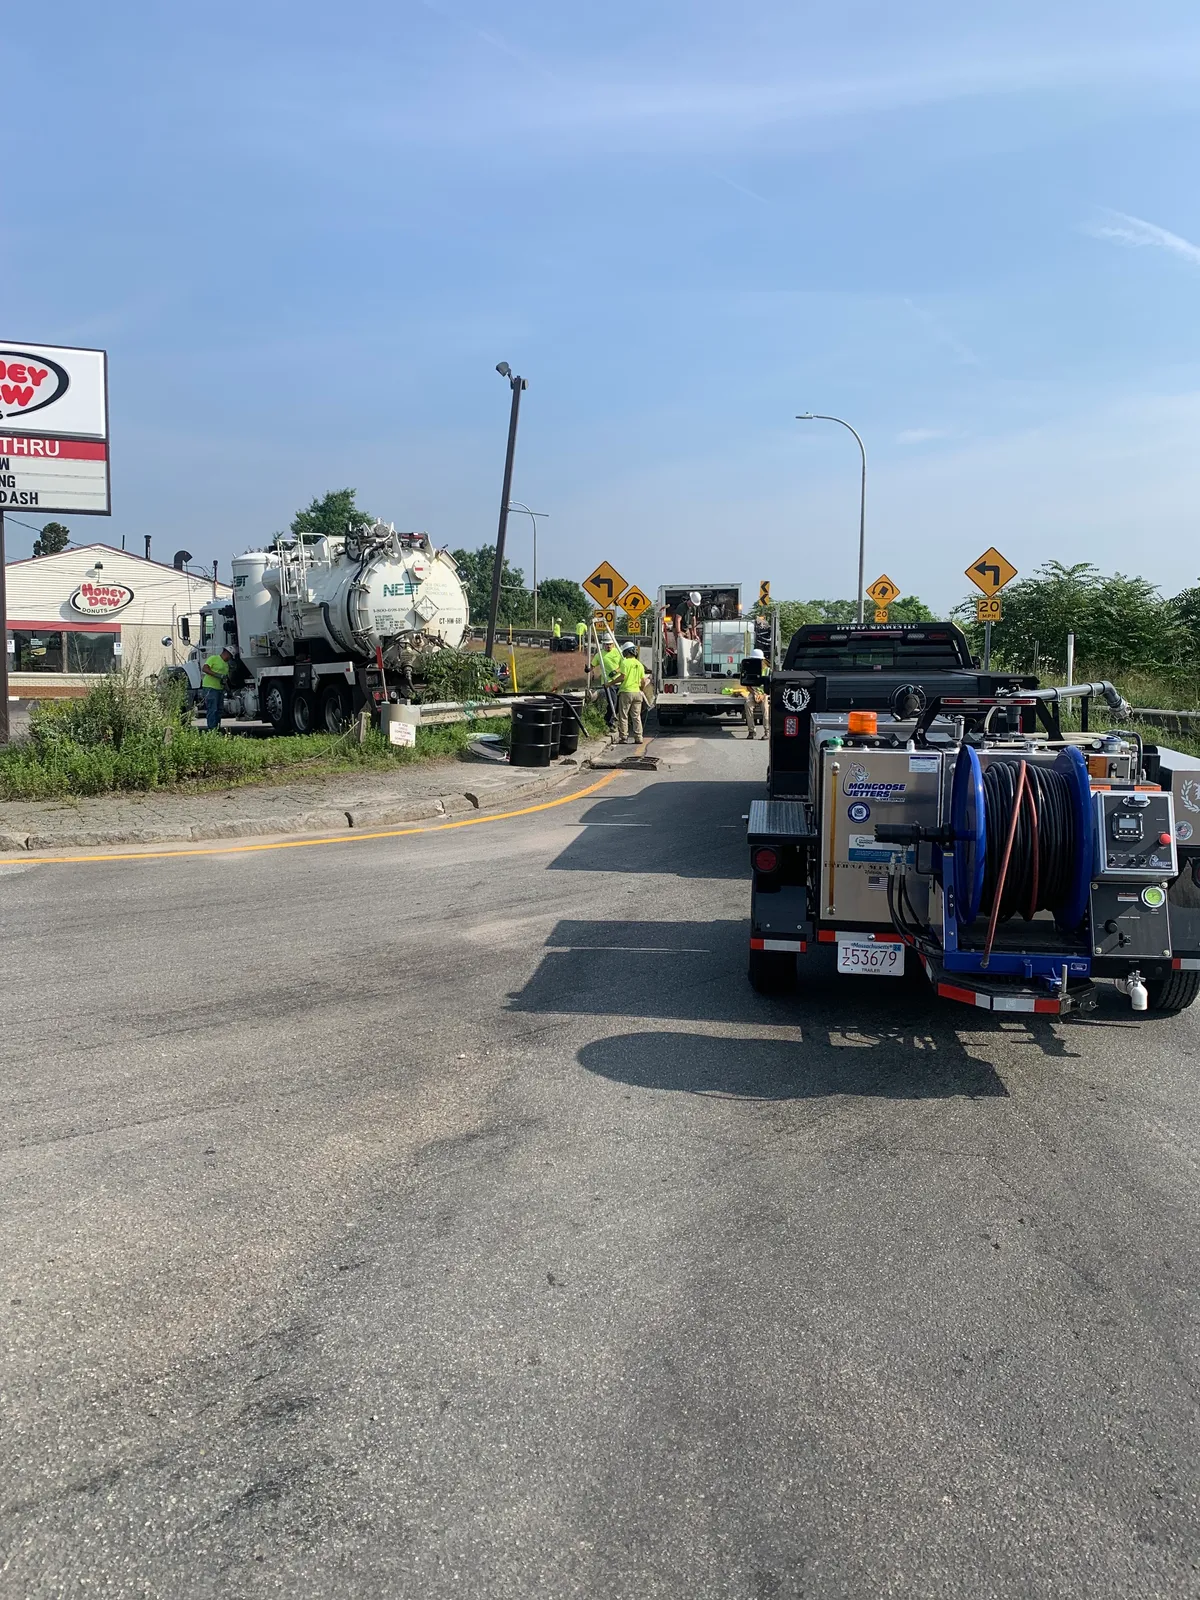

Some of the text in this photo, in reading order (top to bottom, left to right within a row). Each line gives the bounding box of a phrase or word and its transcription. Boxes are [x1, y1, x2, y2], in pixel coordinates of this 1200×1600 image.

[0, 384, 34, 406] W
[0, 437, 59, 456] THRU
[0, 490, 38, 505] DASH
[82, 583, 126, 598] HONEY
[87, 597, 120, 607] DEW
[980, 601, 1000, 612] 20
[851, 948, 897, 967] 53679
